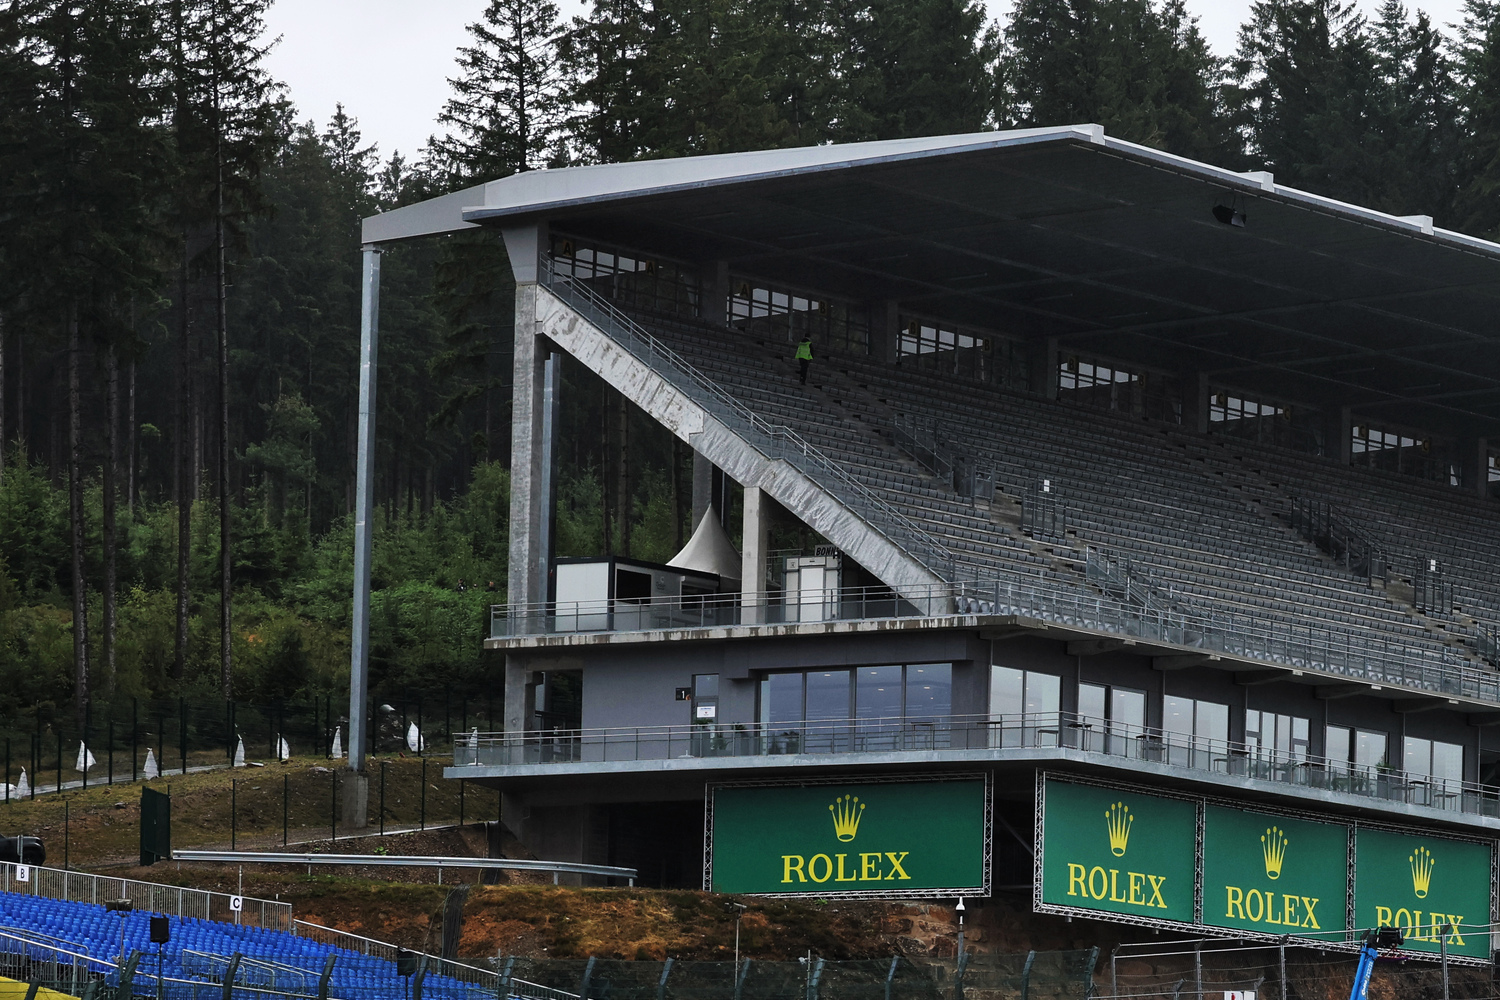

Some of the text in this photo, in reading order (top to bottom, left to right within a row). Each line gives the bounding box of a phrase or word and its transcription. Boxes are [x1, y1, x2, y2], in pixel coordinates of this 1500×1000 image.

[20, 868, 25, 879] B
[780, 852, 911, 883] ROLEX
[1067, 863, 1168, 909] ROLEX
[233, 897, 240, 909] C
[1225, 885, 1321, 930] ROLEX
